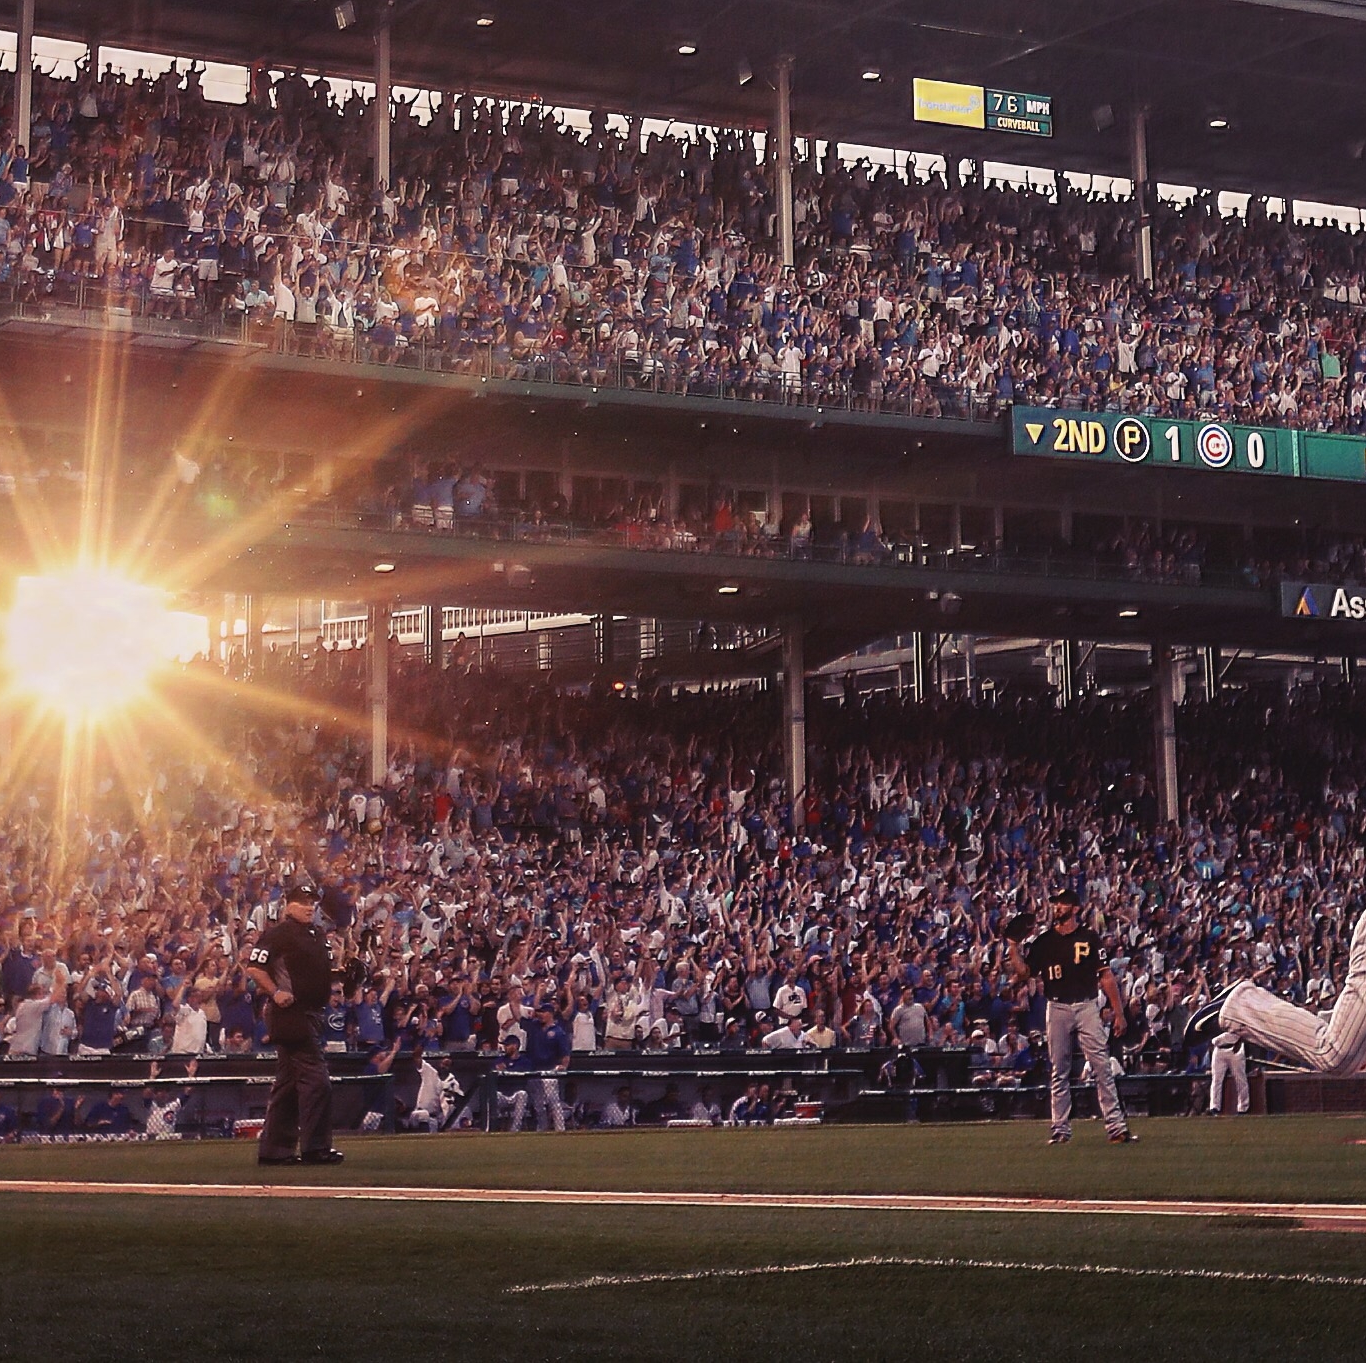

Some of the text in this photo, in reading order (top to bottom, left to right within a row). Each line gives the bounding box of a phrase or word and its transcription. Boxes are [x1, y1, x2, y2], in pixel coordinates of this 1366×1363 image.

[993, 93, 1050, 115] 76 MPH
[997, 116, 1041, 133] CURVEBALL
[1053, 419, 1106, 453] 2ND
[1165, 426, 1180, 461] 1
[1247, 432, 1265, 468] 0
[1073, 941, 1091, 965] P
[1048, 963, 1063, 981] 18
